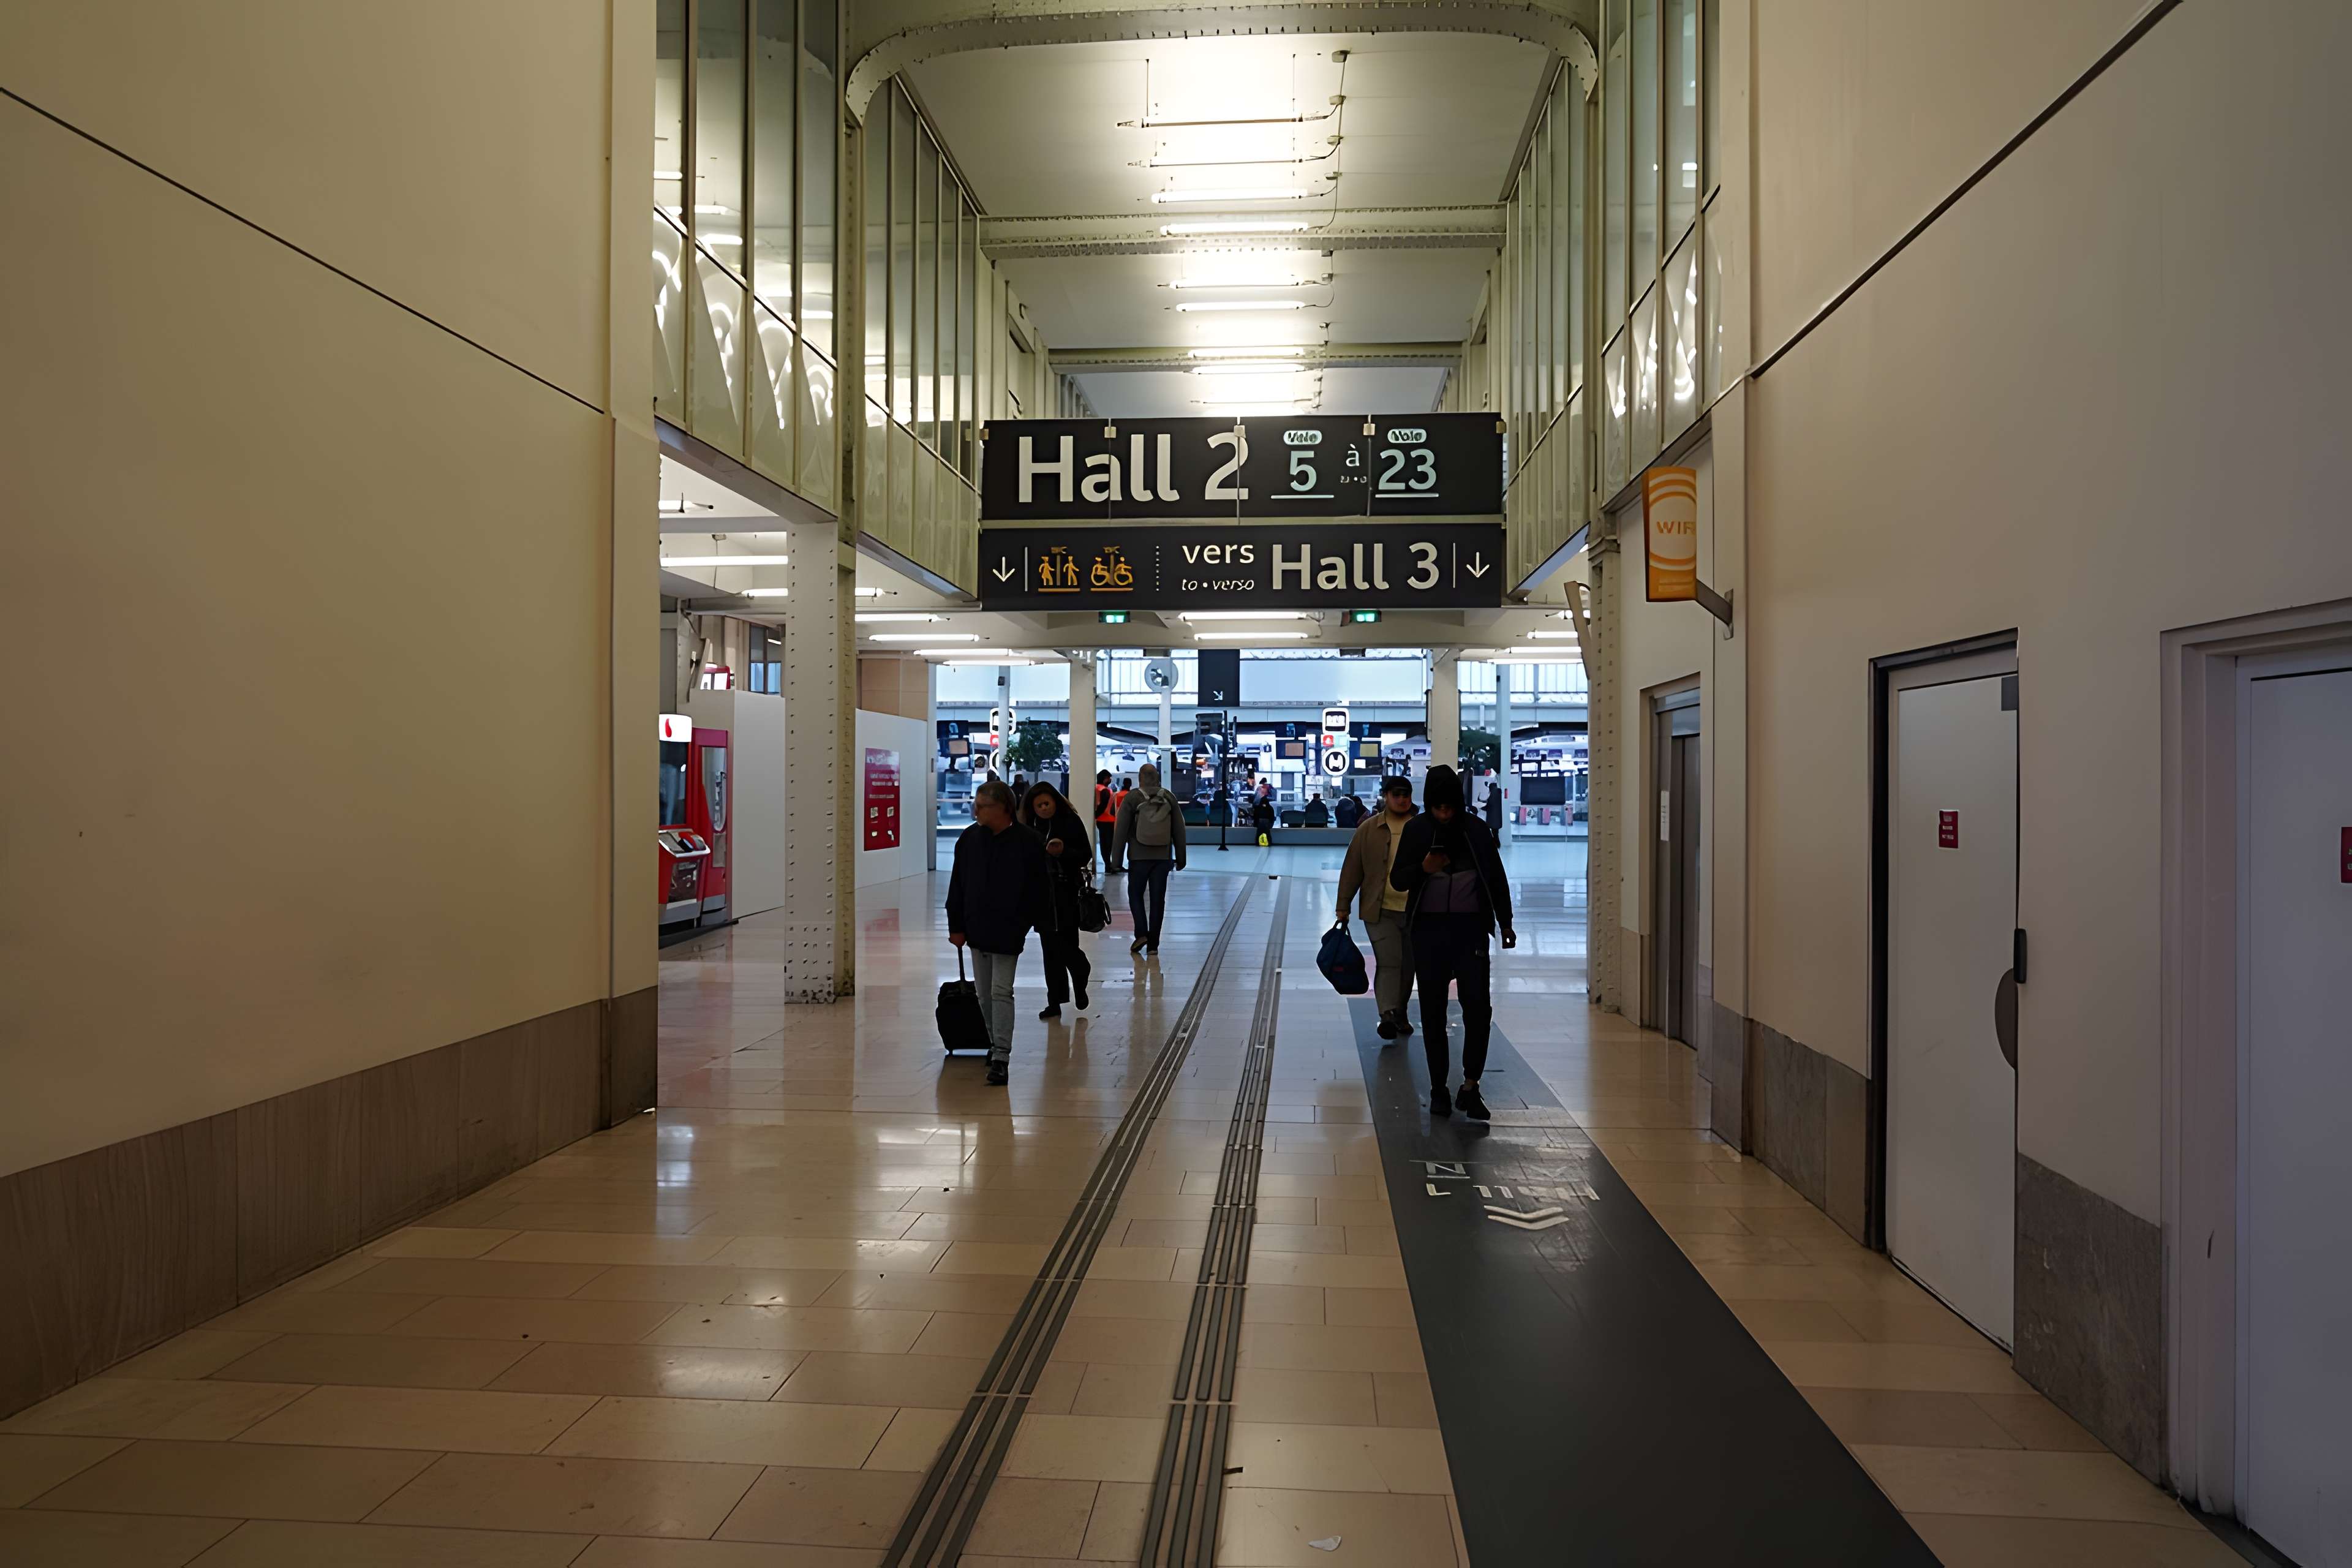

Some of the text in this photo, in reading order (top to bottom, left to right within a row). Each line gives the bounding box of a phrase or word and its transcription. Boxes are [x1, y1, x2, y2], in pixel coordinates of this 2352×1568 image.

[1019, 432, 1249, 503] Hall 2
[1290, 443, 1436, 492] 5 à 23
[1182, 545, 1254, 564] vers
[1272, 542, 1439, 590] Hall 3
[1182, 579, 1198, 591] to
